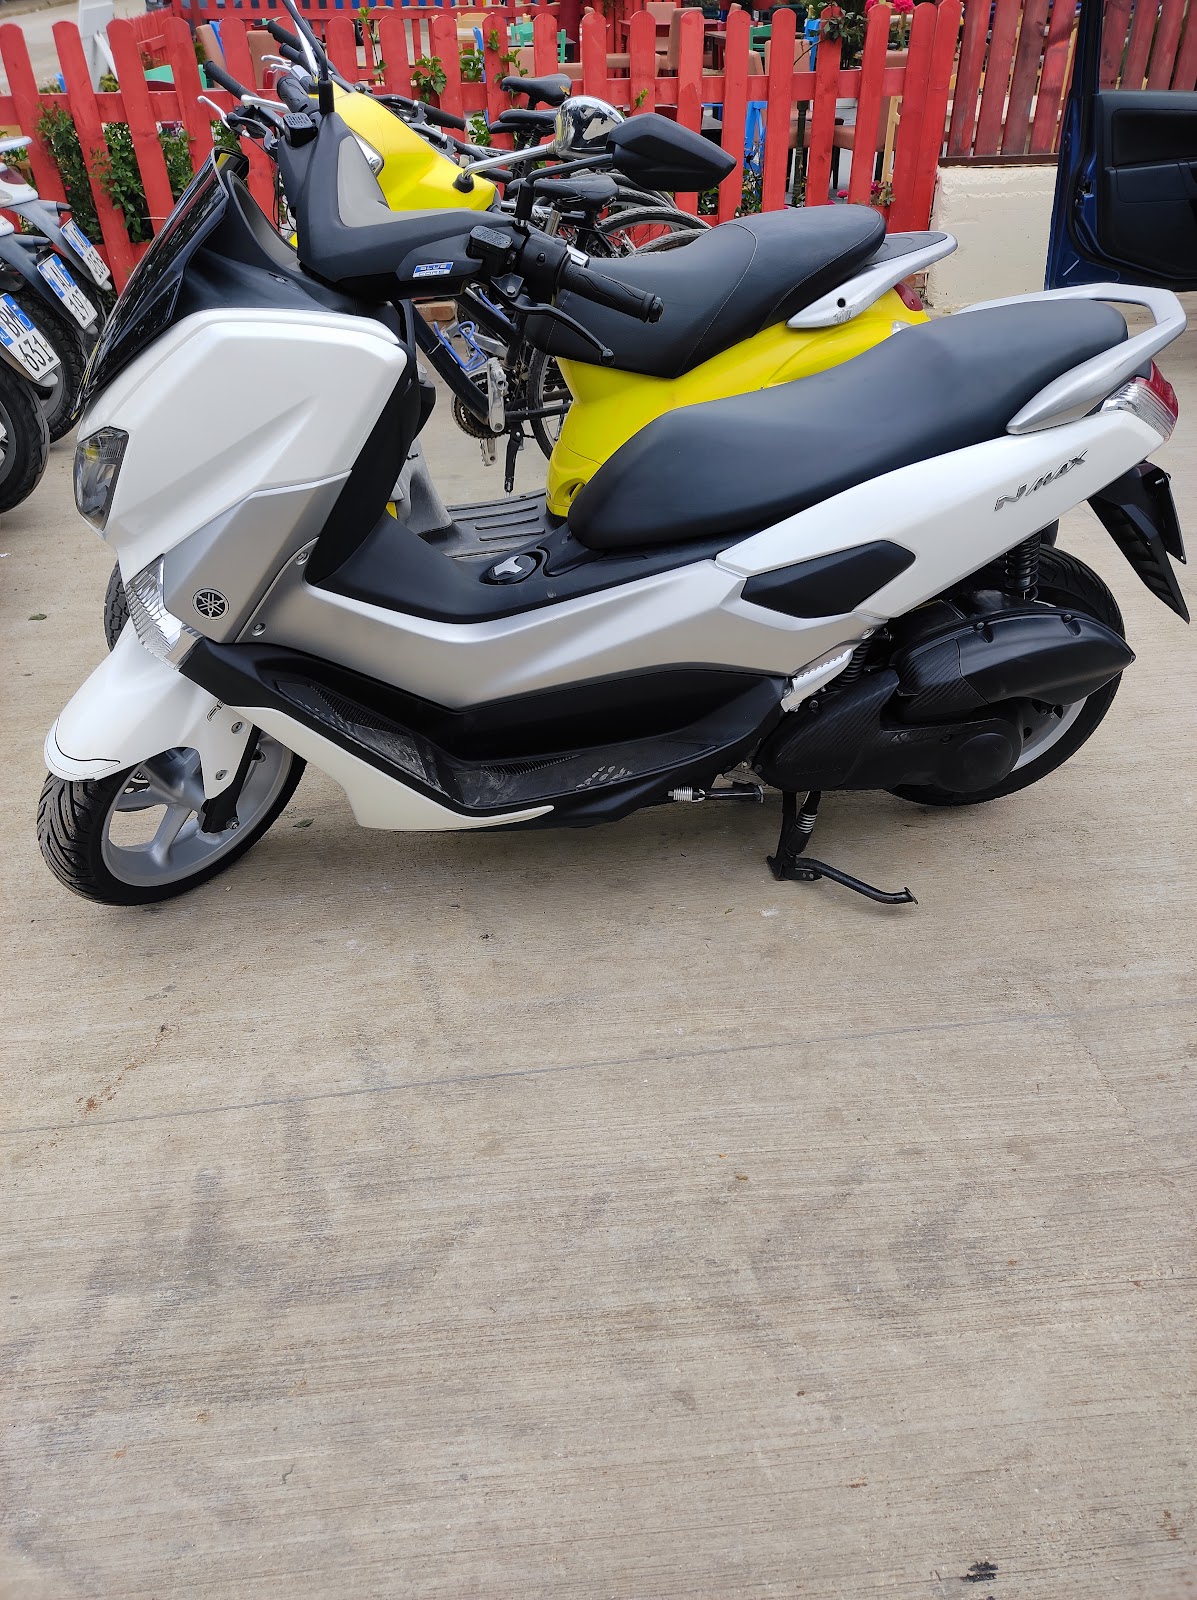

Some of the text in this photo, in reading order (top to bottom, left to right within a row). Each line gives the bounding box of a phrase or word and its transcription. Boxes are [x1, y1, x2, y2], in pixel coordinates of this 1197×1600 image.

[0, 305, 28, 337] BM
[67, 289, 92, 321] 197
[17, 334, 54, 372] 631
[994, 448, 1088, 512] NMAX
